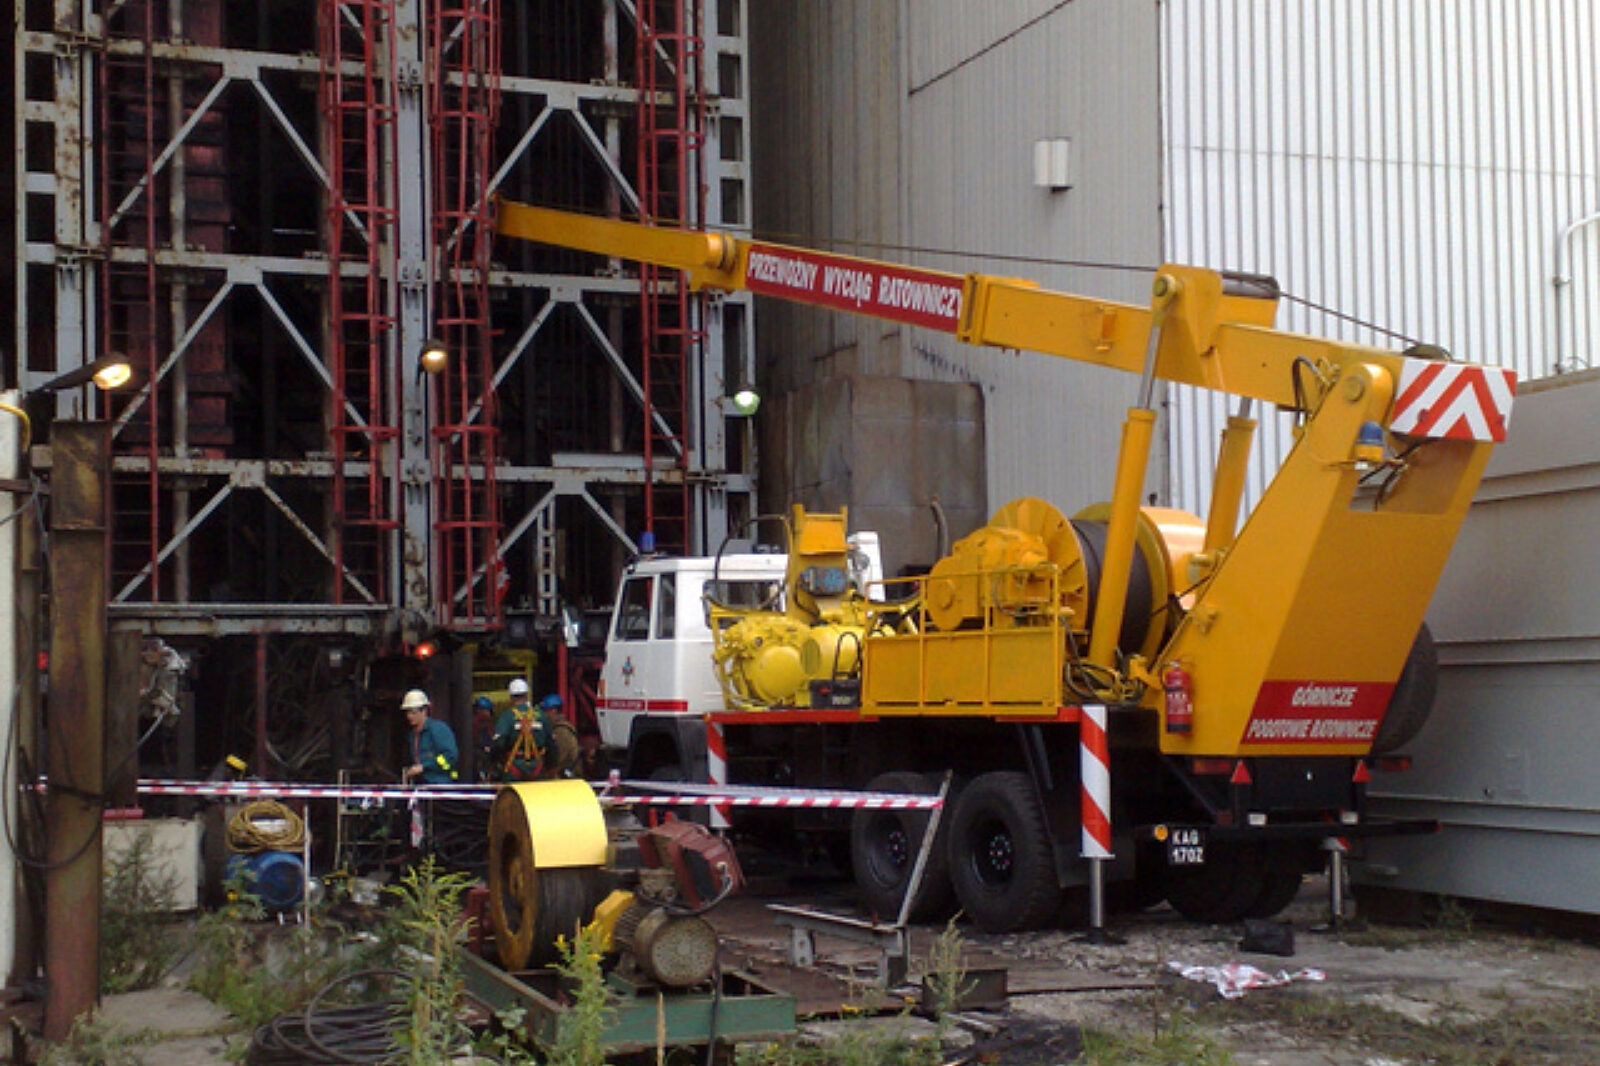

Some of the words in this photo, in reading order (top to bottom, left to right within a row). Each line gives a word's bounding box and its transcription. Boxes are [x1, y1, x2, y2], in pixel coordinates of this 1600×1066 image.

[823, 266, 874, 307] WYCIĄG
[1291, 681, 1358, 707] GÓRNICZE
[1247, 718, 1313, 739] POGOTOWIE
[1309, 718, 1378, 739] RATOWNICZE
